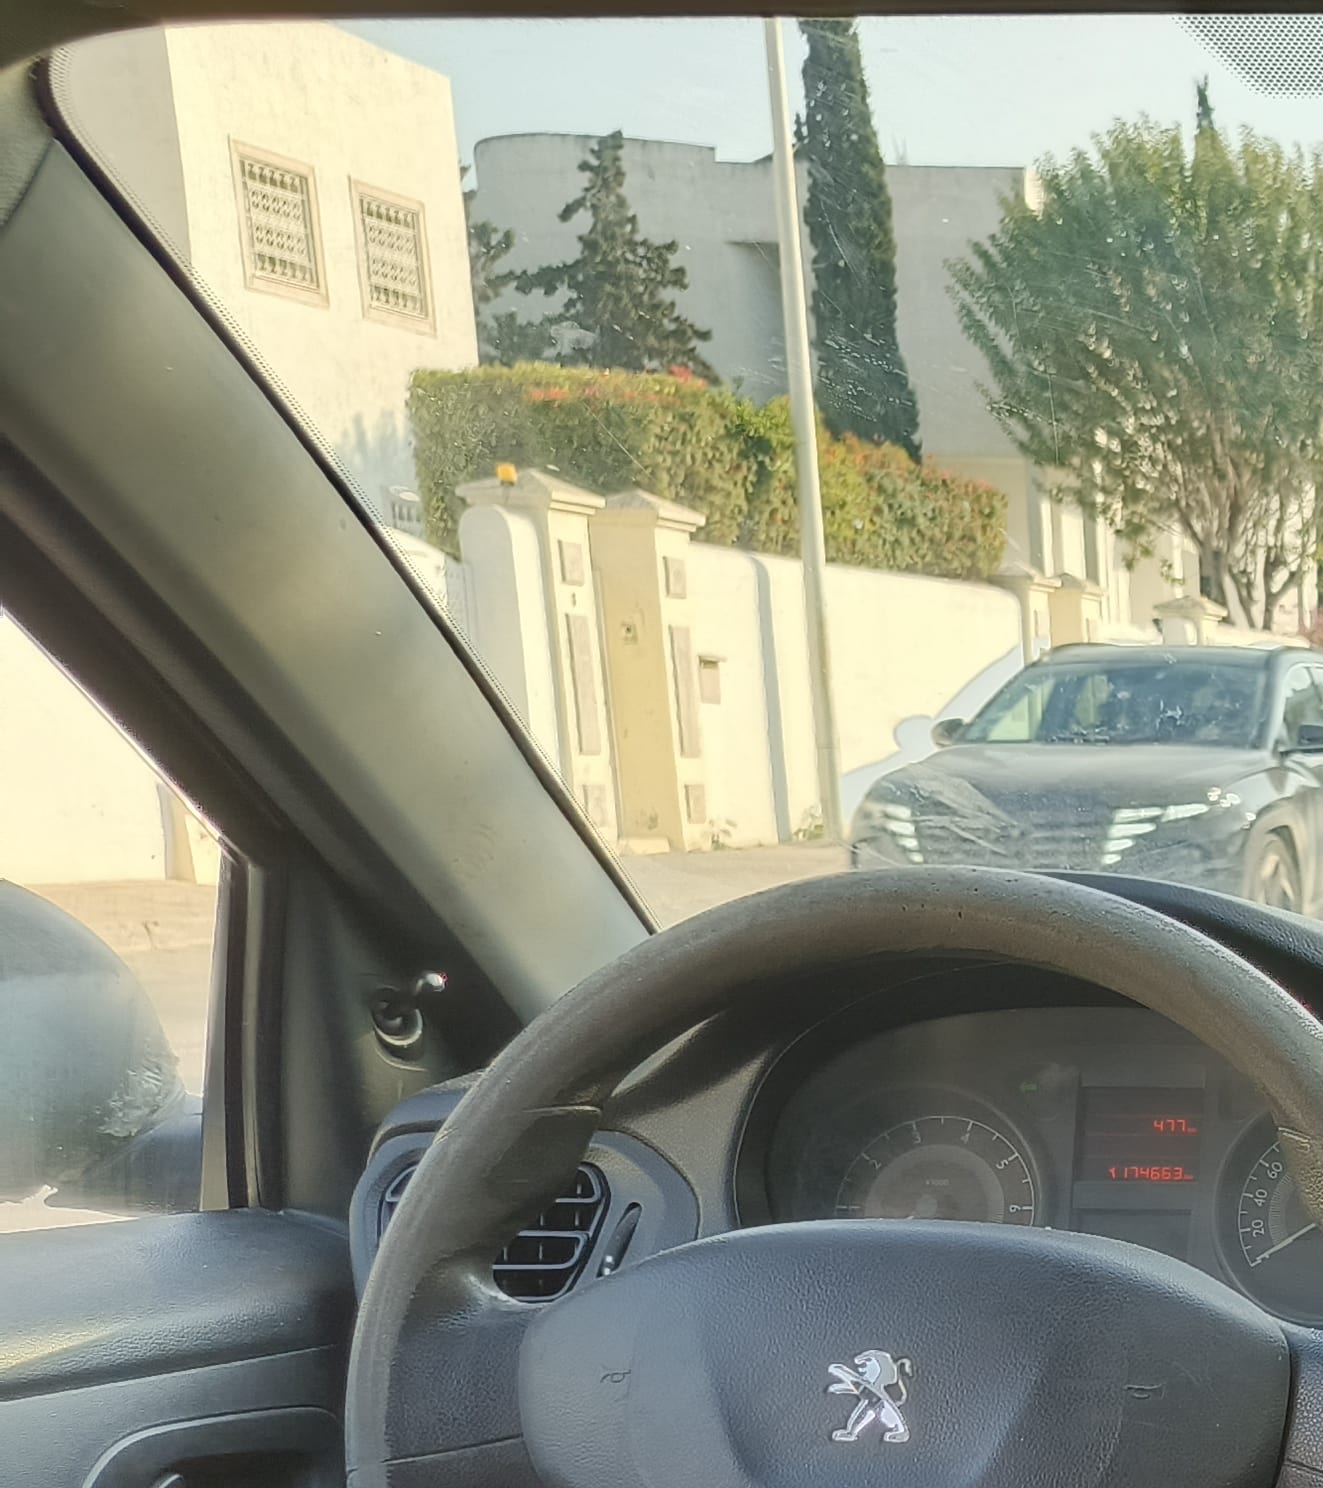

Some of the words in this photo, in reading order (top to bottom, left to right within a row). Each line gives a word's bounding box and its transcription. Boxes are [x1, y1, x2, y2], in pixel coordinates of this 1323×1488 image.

[1152, 1119, 1186, 1133] 477
[1266, 1161, 1283, 1180] 60
[996, 1158, 1009, 1170] 5
[1009, 1204, 1022, 1214] 6
[1254, 1188, 1268, 1207] 40
[1251, 1219, 1266, 1238] 20
